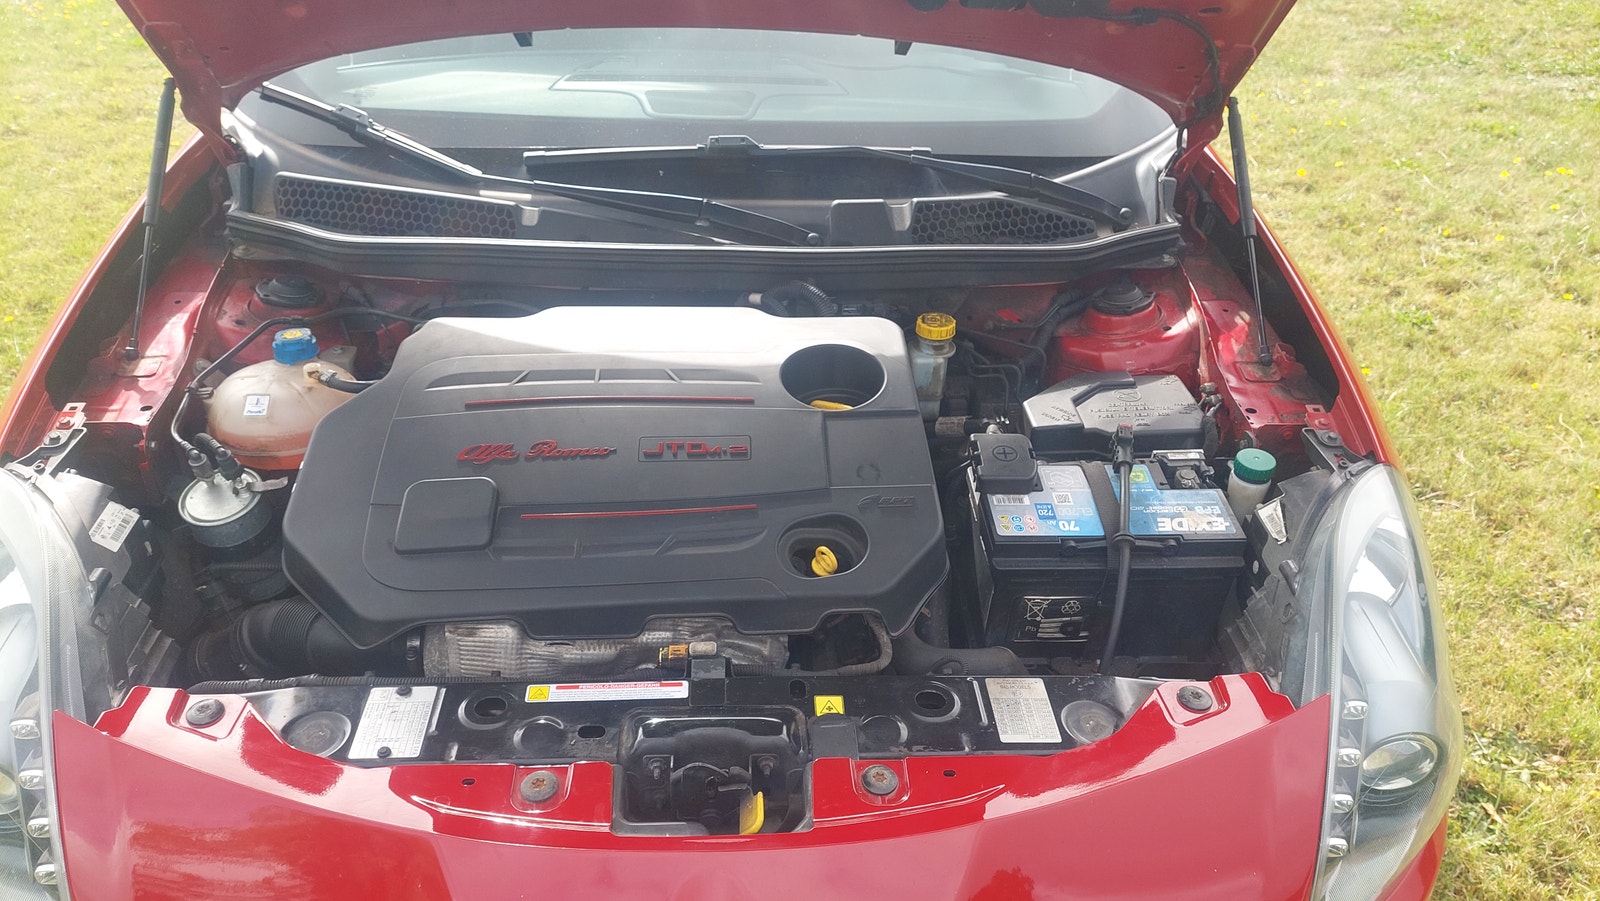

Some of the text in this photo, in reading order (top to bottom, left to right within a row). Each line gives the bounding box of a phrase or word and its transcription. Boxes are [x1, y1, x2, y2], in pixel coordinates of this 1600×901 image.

[456, 439, 617, 465] Alfa Romeo
[1058, 520, 1081, 532] 70
[1156, 517, 1230, 532] EXIDE
